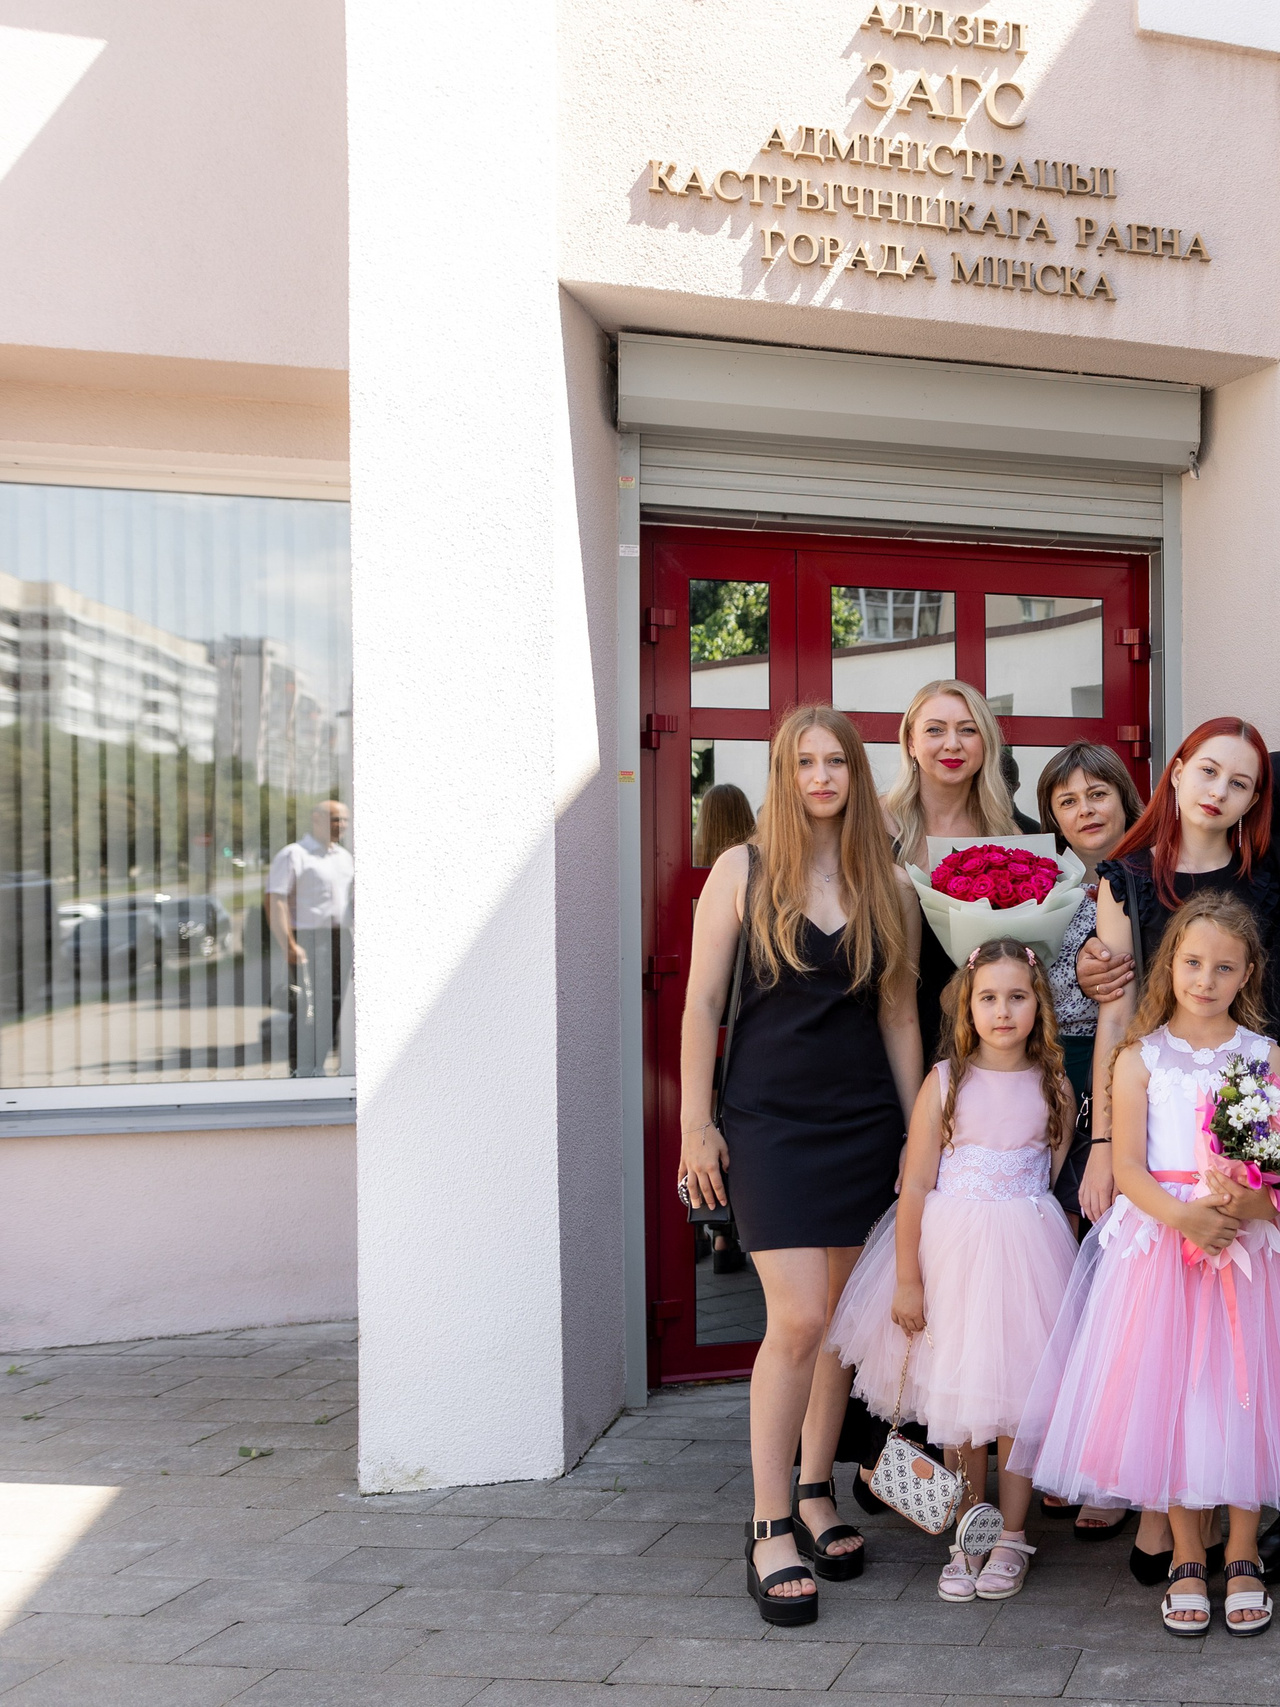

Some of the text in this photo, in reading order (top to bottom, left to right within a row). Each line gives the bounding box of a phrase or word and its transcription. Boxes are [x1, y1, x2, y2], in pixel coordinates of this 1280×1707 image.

[860, 1, 1029, 55] АДДЗЕЛ
[864, 58, 1028, 129] ЗАГС
[760, 122, 1118, 199] АДМІНІСТРАЦЫІ
[648, 159, 1213, 262] КАСТРЫЧНІЦКАГА РАЕНА
[760, 228, 1118, 302] ГОРАДА МІНСКА
